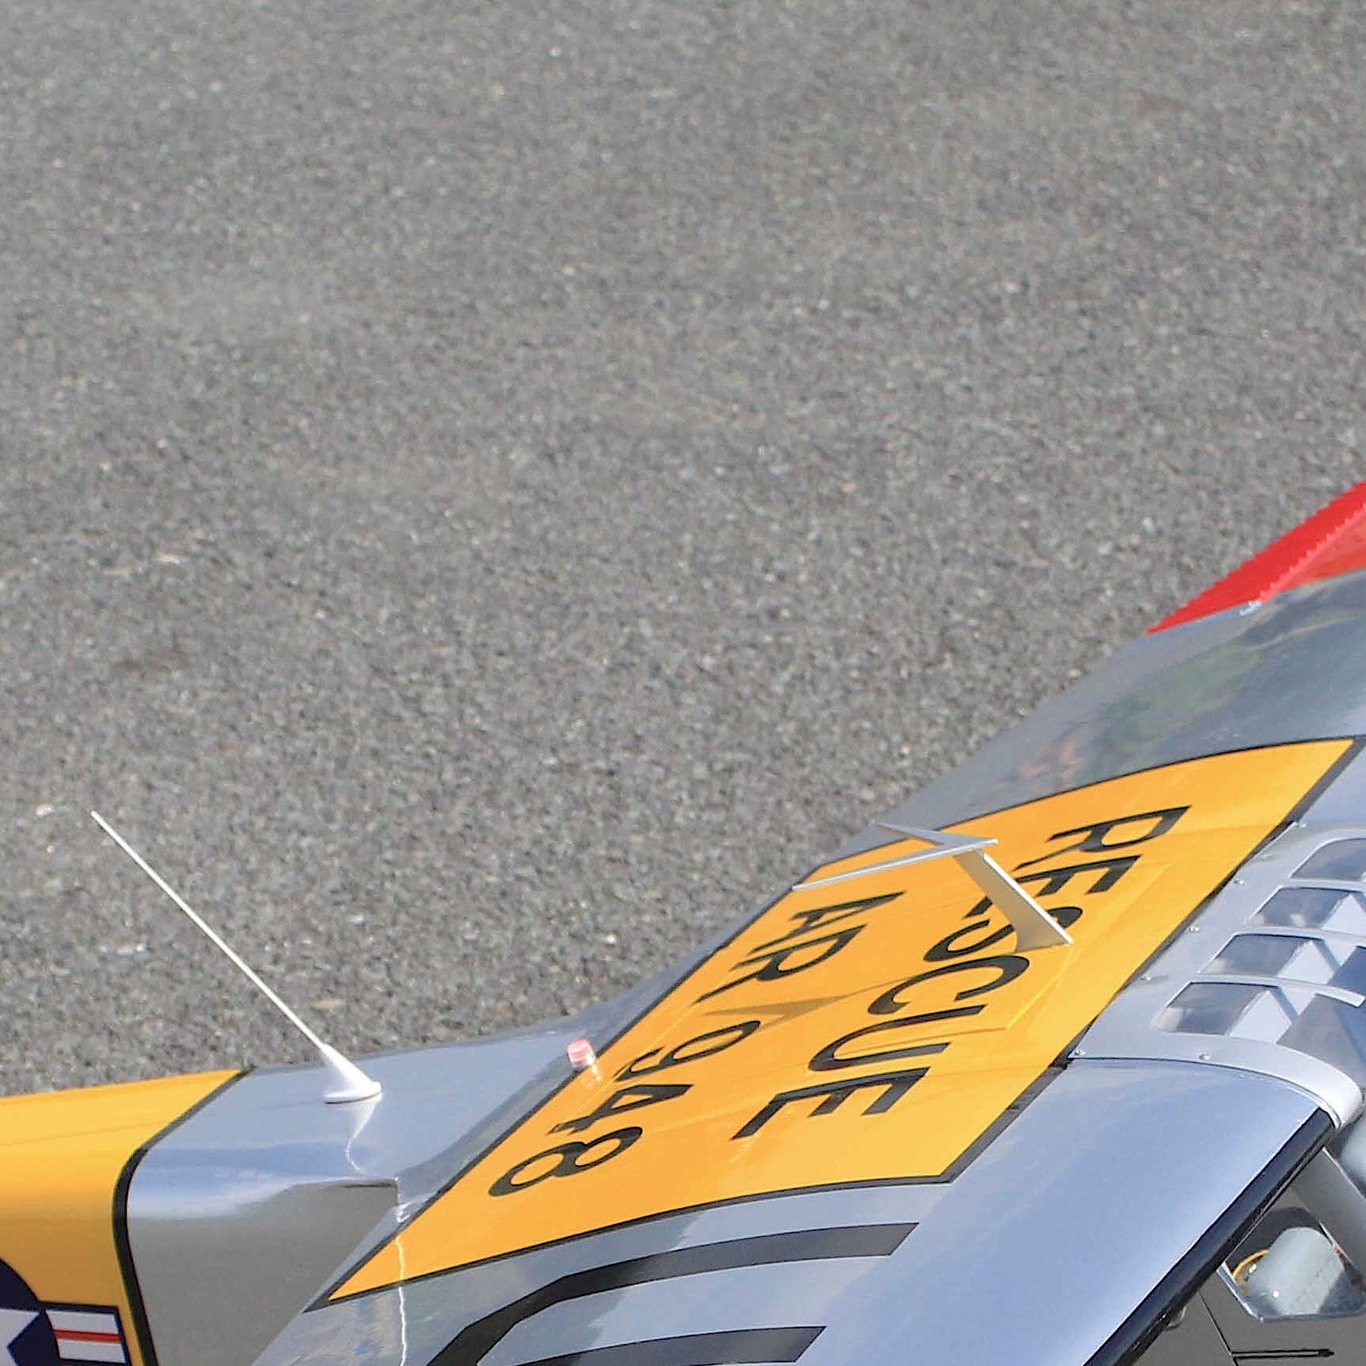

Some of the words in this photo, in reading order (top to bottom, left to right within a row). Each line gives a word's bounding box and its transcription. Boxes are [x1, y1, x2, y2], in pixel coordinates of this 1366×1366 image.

[688, 890, 906, 1006] AR
[730, 805, 1192, 1141] RESCUE
[487, 1019, 762, 1197] 948
